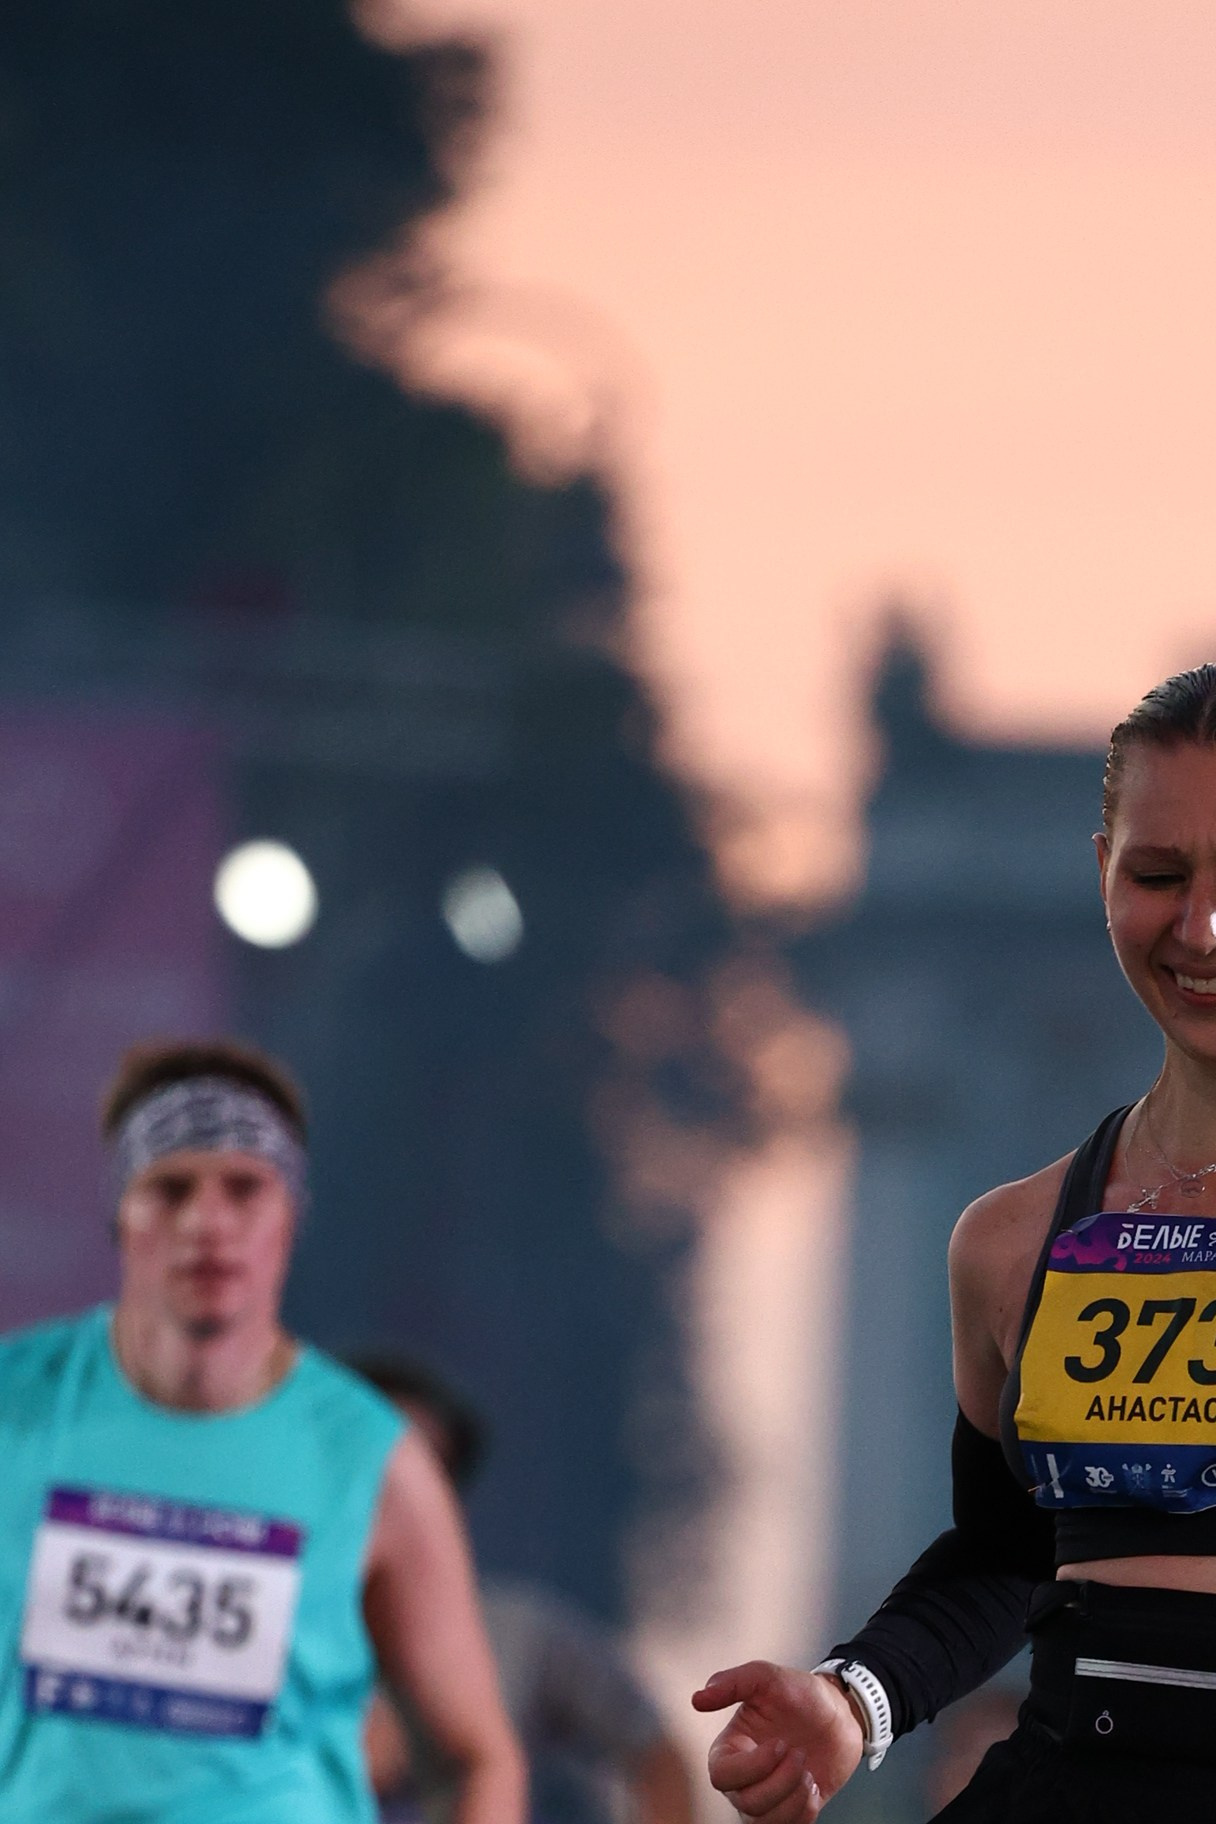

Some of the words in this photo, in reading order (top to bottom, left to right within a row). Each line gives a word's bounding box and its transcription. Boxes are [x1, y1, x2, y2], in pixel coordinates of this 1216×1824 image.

[1116, 1222, 1205, 1250] БЕЛЫЕ
[1133, 1252, 1172, 1265] 2024
[62, 1550, 258, 1654] 5435
